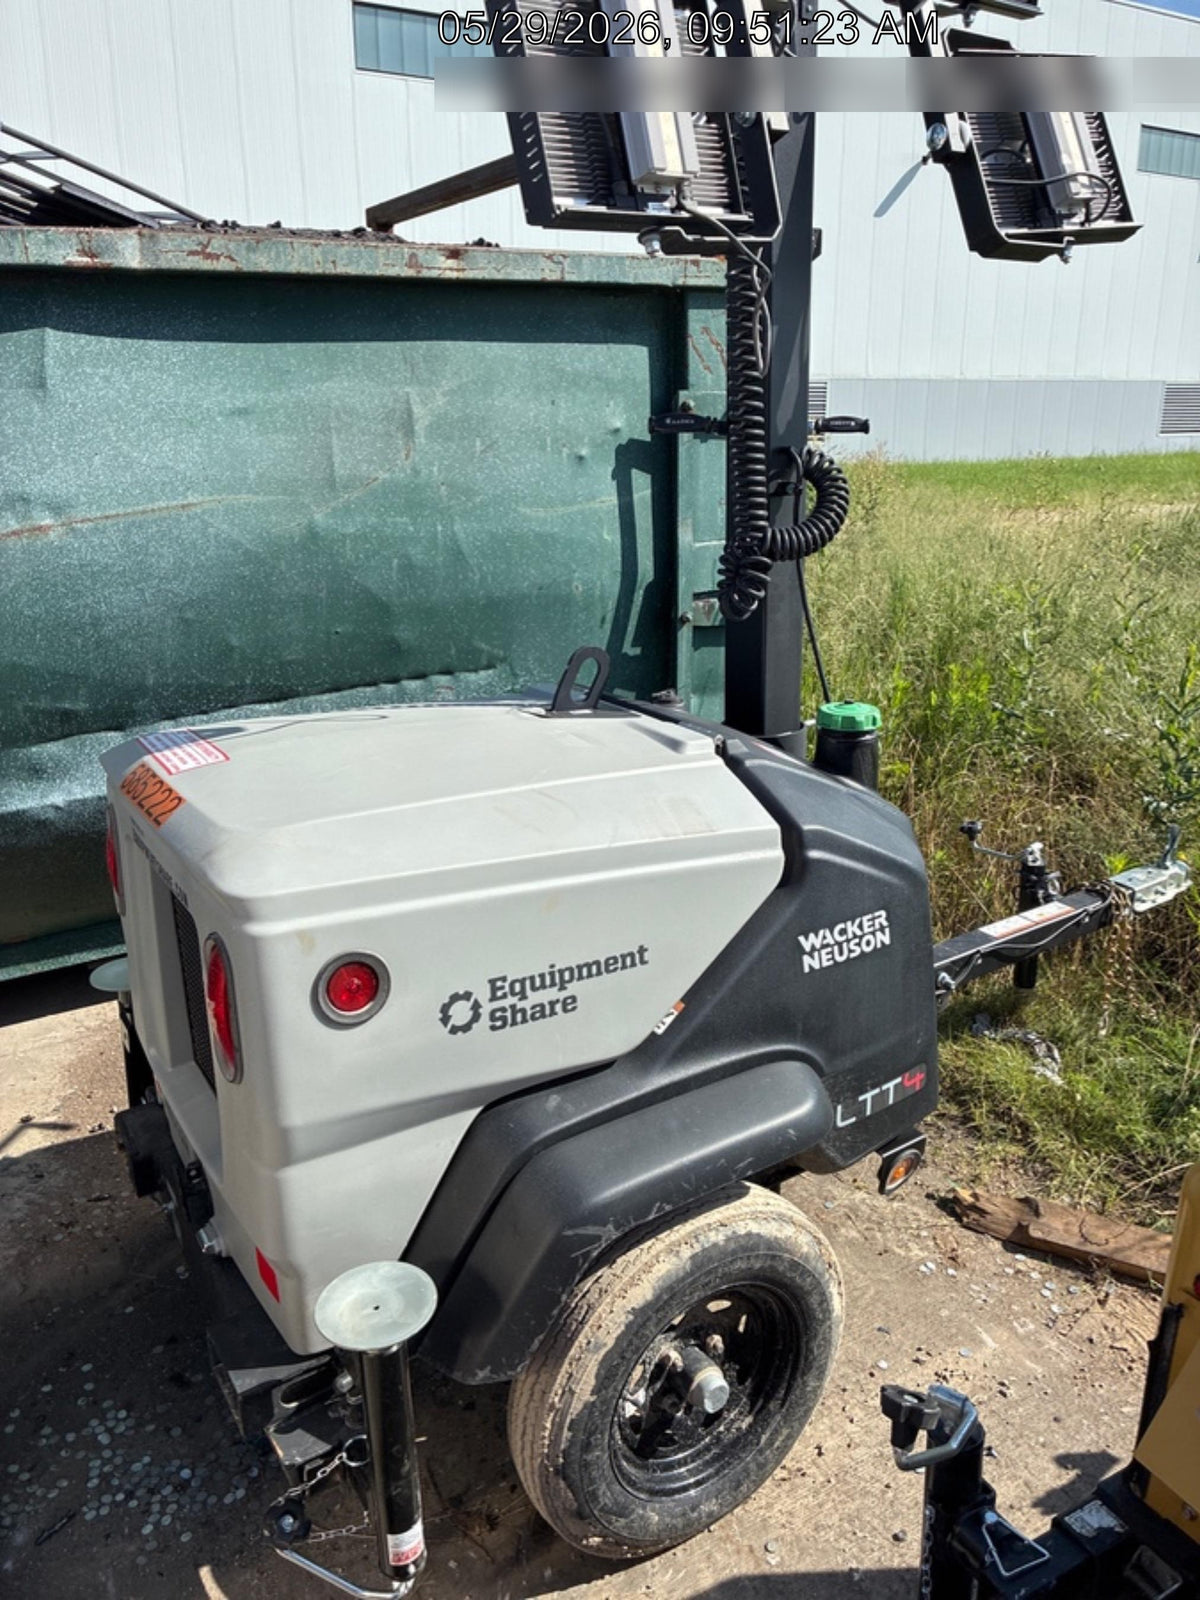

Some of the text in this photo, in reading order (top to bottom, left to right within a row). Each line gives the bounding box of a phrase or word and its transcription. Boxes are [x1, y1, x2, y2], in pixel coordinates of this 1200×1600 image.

[798, 909, 889, 952] WACKER
[802, 928, 891, 973] NEUSON
[487, 945, 648, 1002] Equipment
[488, 994, 578, 1031] Share
[836, 1072, 925, 1128] LTT4
